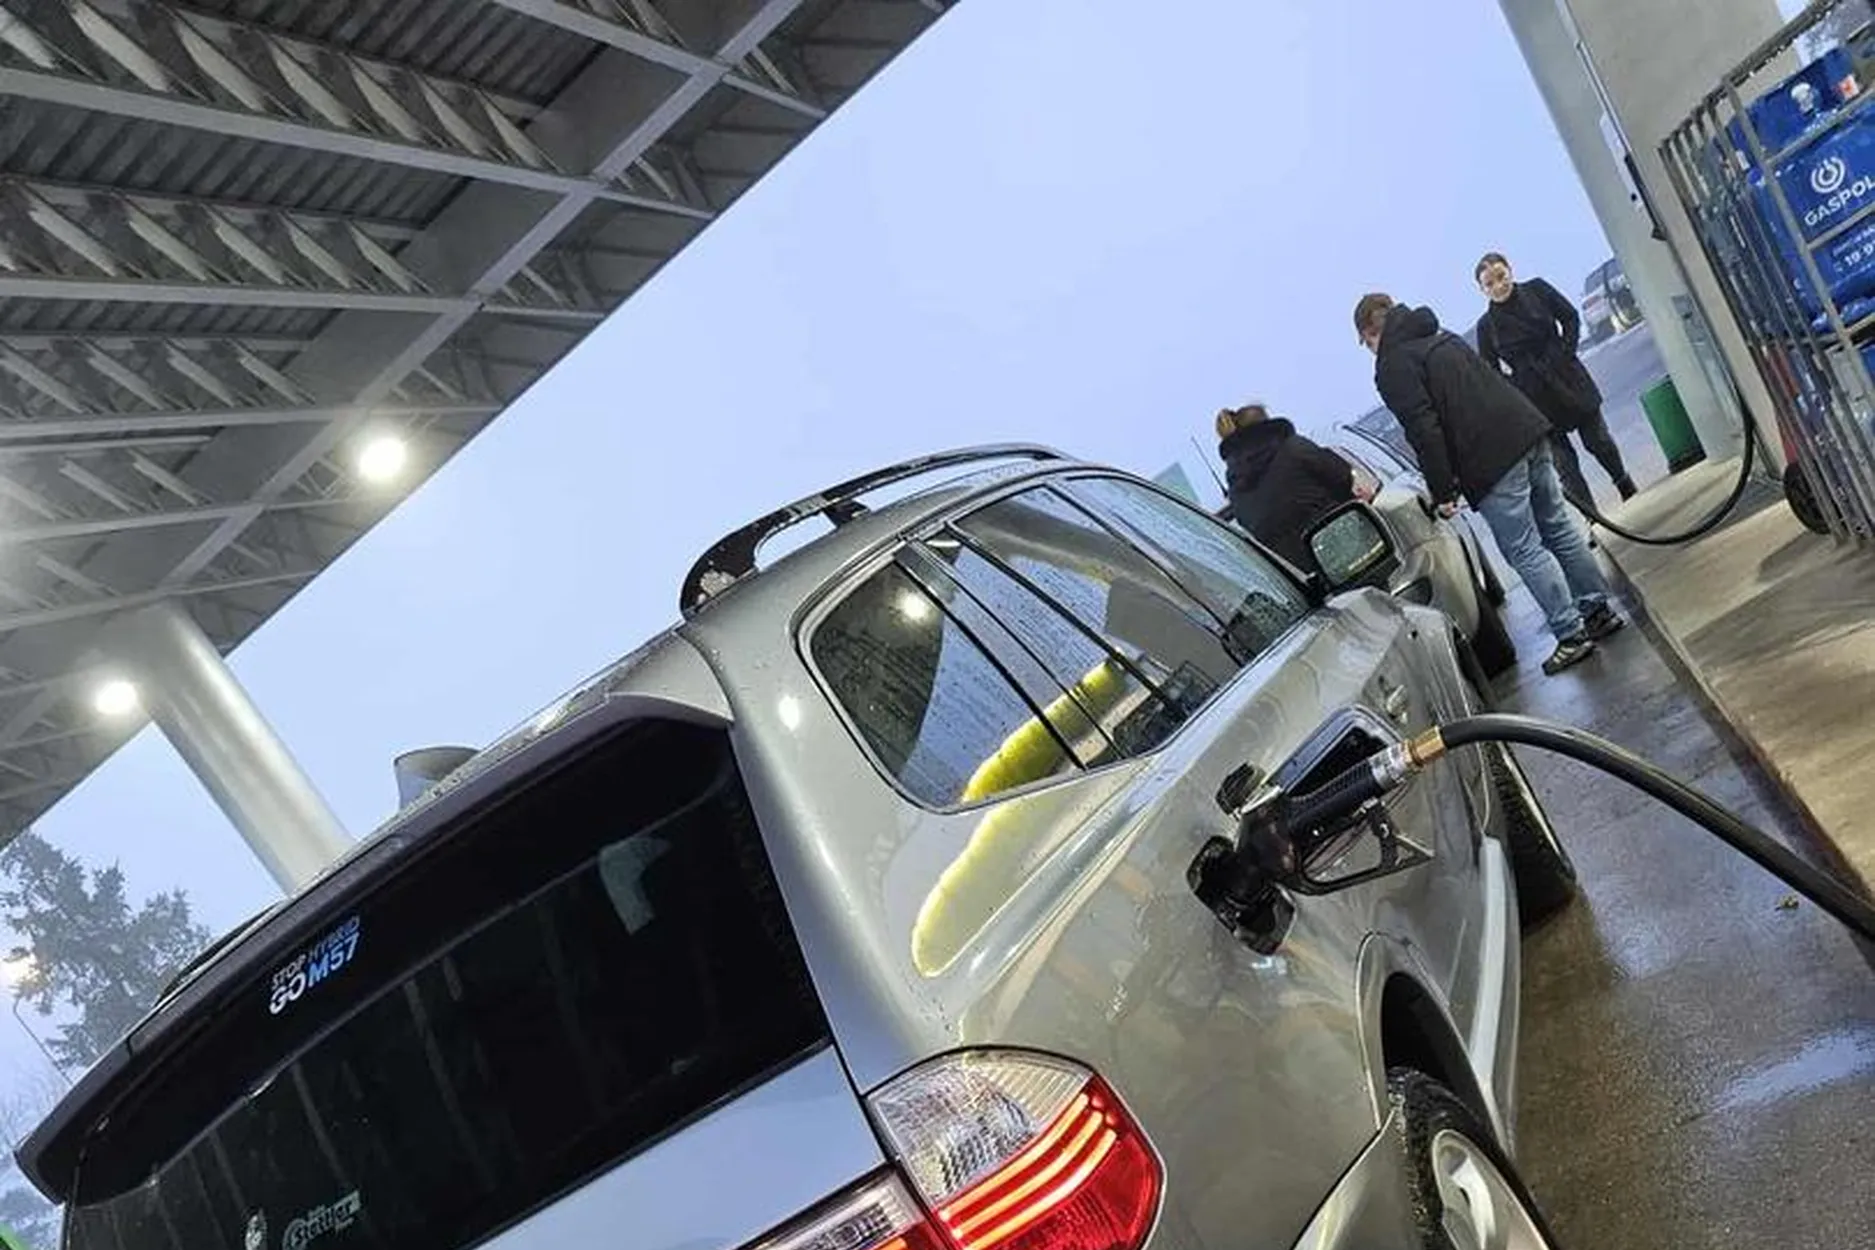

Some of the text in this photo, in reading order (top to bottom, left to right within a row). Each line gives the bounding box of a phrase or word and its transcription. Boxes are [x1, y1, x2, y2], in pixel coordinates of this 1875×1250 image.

[1804, 175, 1875, 227] GASPOL
[269, 932, 360, 1014] GO M57
[271, 954, 307, 992] STOP
